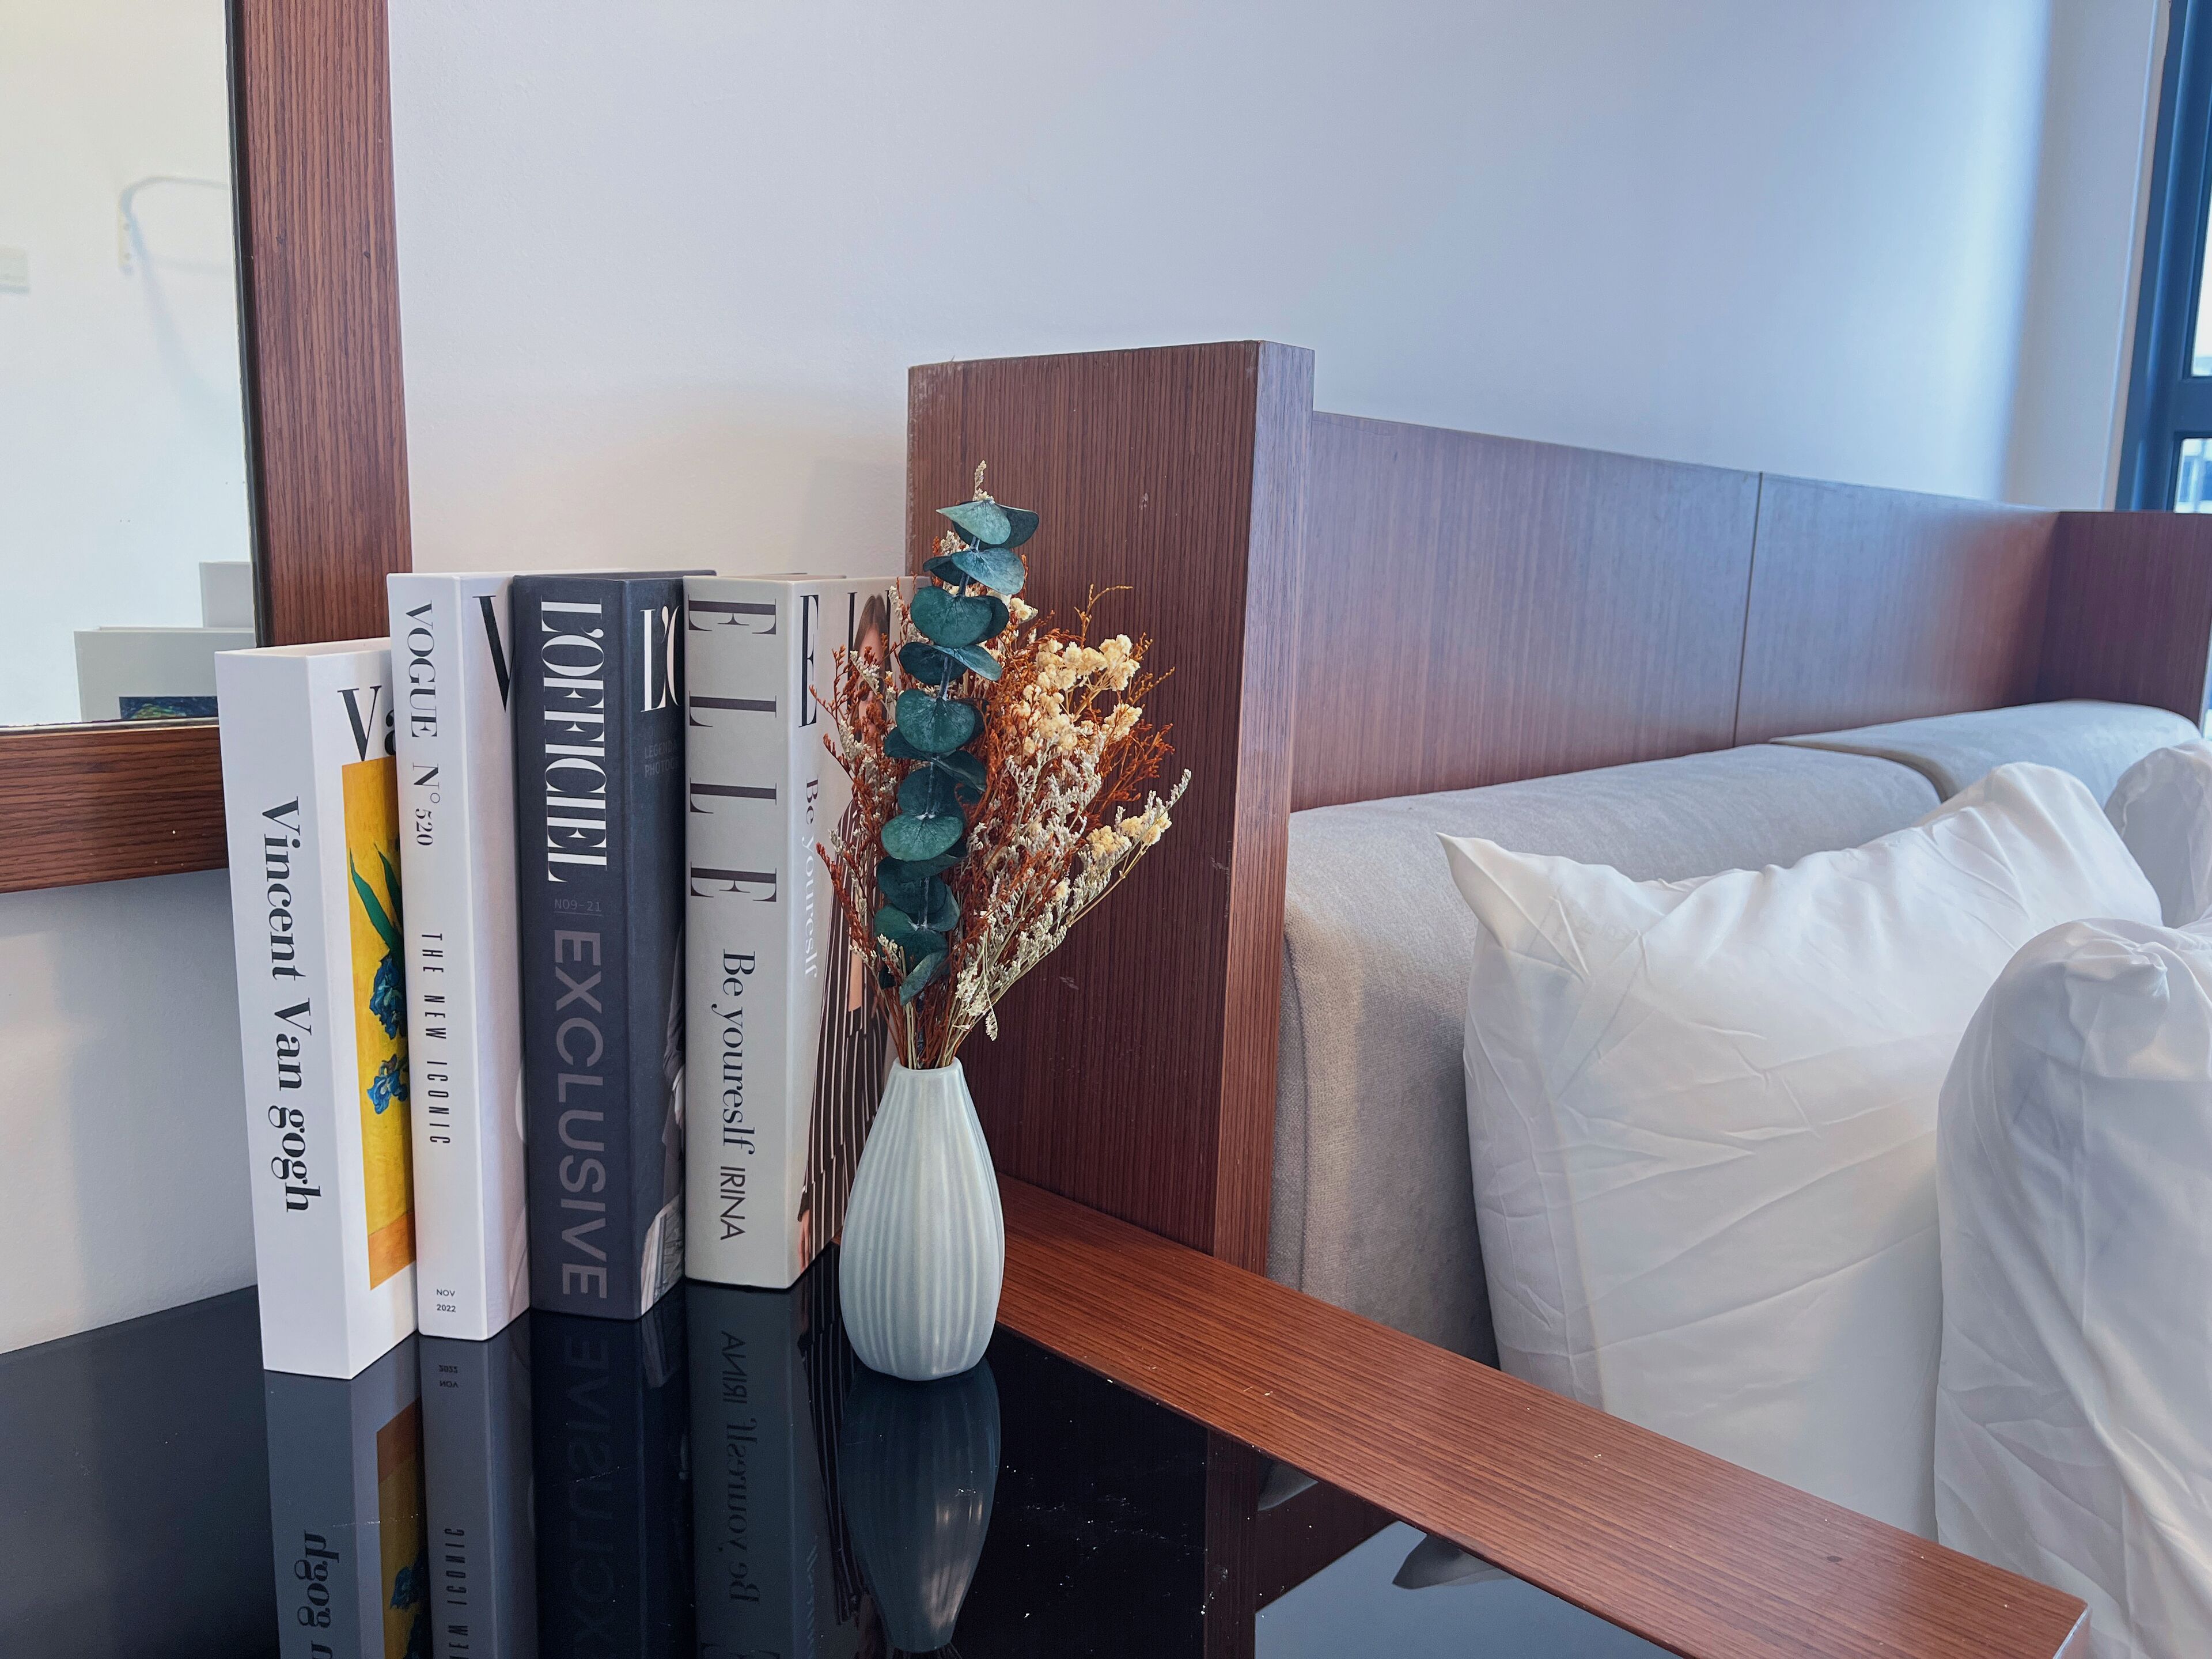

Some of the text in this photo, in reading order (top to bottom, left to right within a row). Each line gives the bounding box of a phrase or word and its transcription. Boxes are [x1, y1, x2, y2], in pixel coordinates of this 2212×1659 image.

[406, 600, 437, 738] VOGUE
[688, 594, 777, 903] ELLE
[262, 796, 322, 1213] Vincent Van gogh
[421, 933, 451, 1144] THE NEW ICONIC
[723, 949, 755, 997] Be
[554, 929, 607, 1299] EXCLUSIVE
[719, 1165, 747, 1241] IRINA
[436, 1289, 456, 1297] NOV
[436, 1304, 456, 1313] 2022
